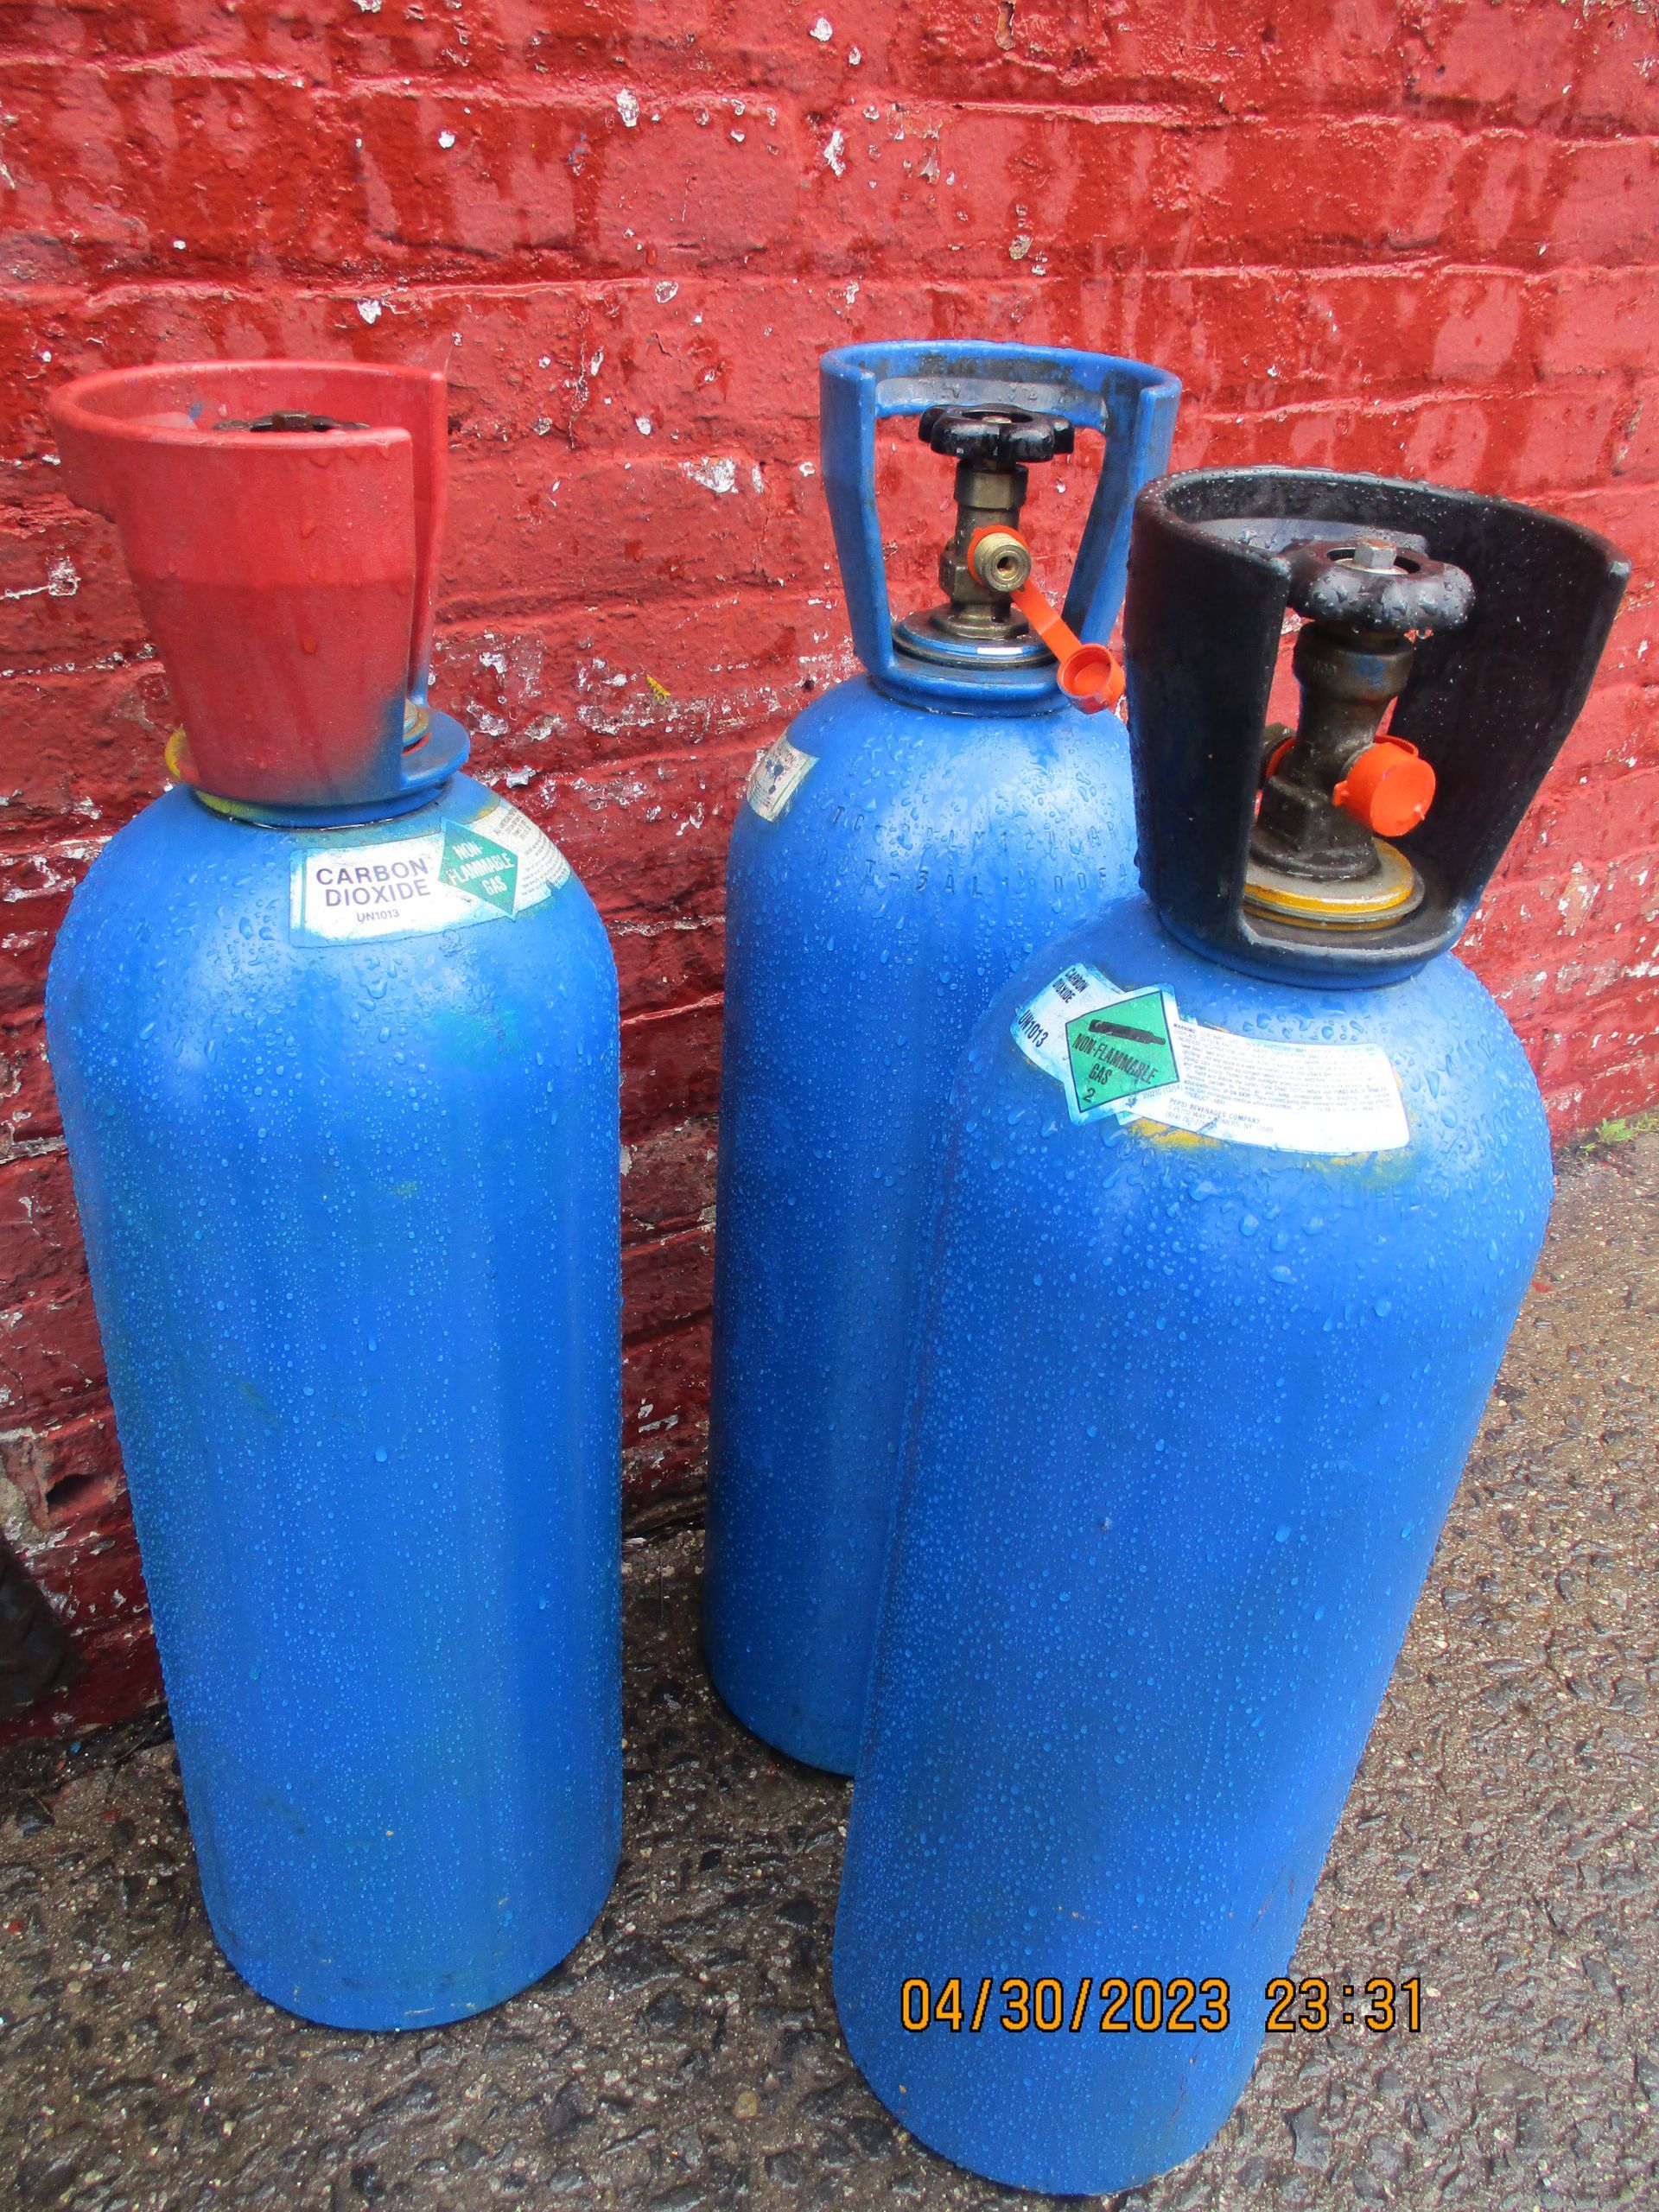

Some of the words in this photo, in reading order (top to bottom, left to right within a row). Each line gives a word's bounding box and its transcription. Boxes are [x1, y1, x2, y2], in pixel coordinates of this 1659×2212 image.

[452, 840, 484, 861] NON-
[316, 858, 429, 886] CARBON
[446, 853, 515, 886] FLAMMABLE
[326, 879, 431, 906] DIOXIDE
[481, 874, 509, 895] GAS
[356, 911, 400, 923] UN1013
[1052, 978, 1077, 1004] DIOXIDE
[1065, 968, 1090, 993] CARBON
[1017, 1009, 1049, 1048] UN1013
[1072, 1033, 1159, 1084] NON-FLAMMABLE
[1088, 1063, 1113, 1085] GAS
[1083, 1088, 1096, 1103] 2
[1169, 1097, 1189, 1110] PEPSI
[1189, 1103, 1226, 1117] BEVERAGES
[1229, 1111, 1261, 1124] COMPANY
